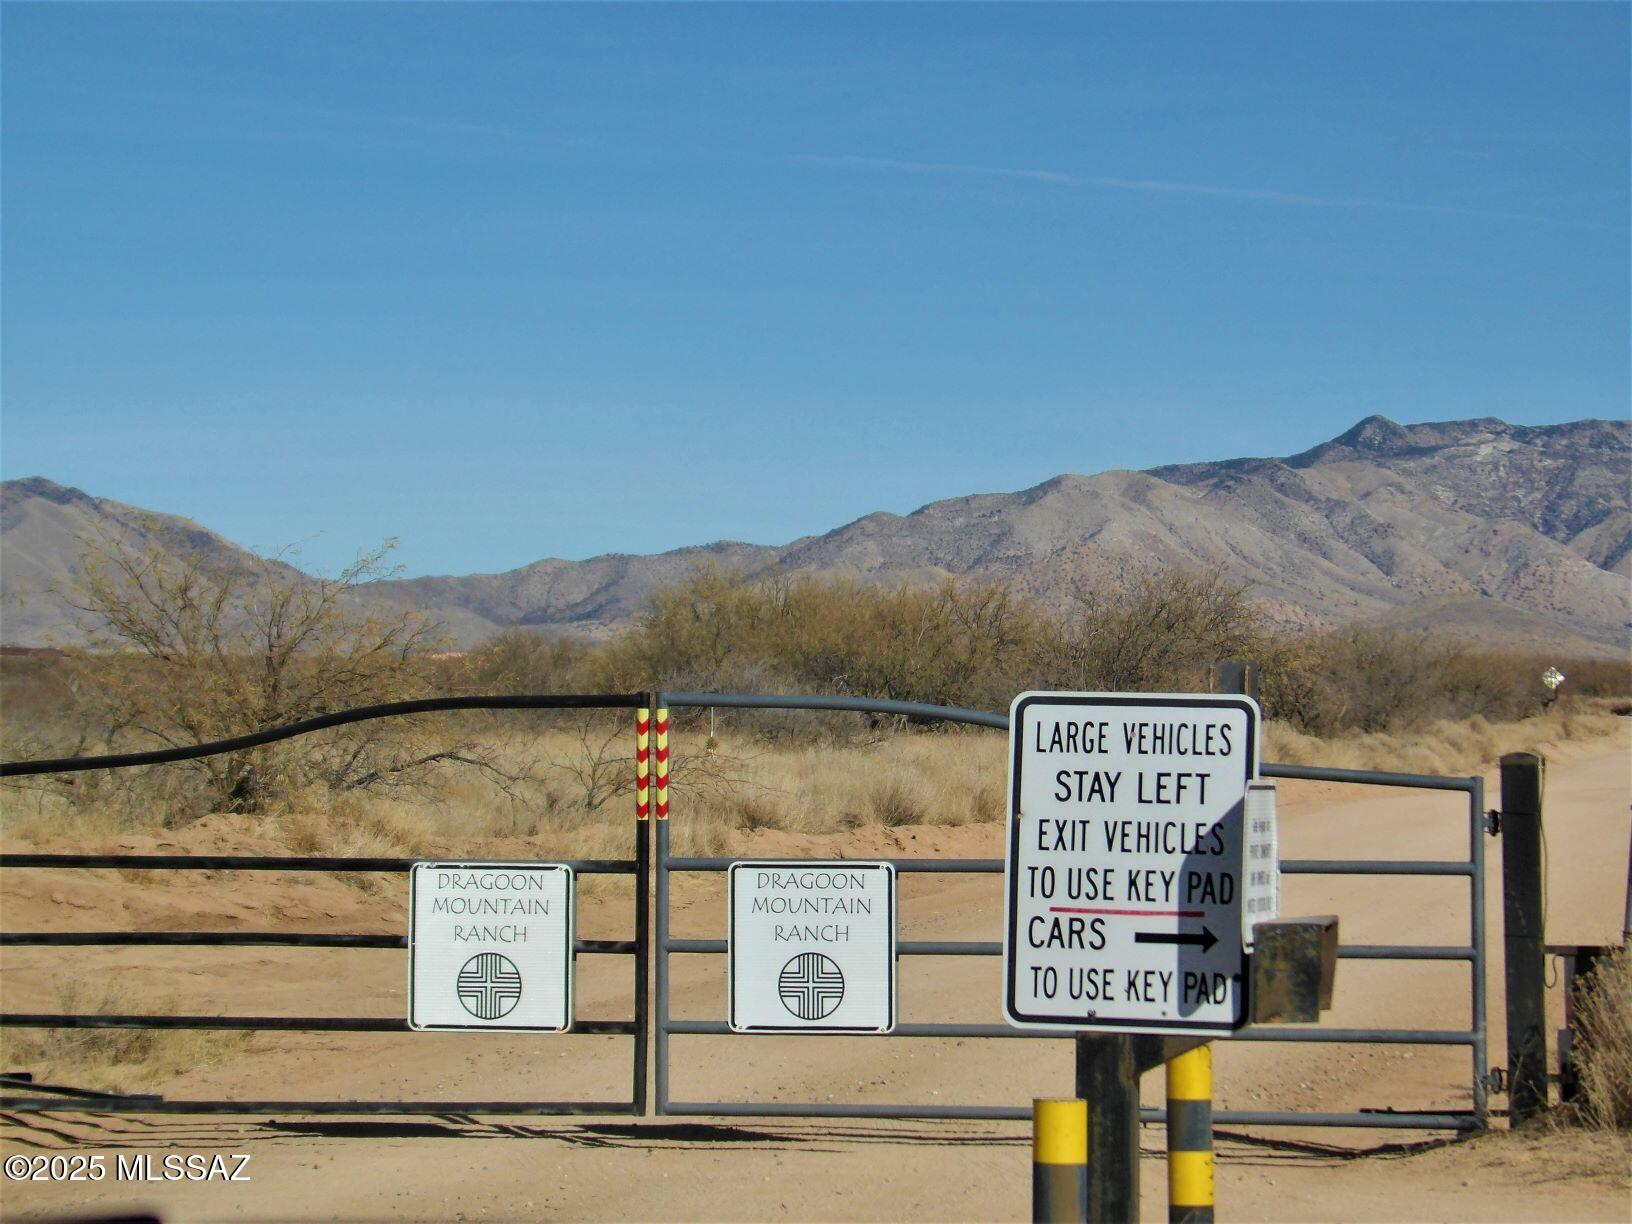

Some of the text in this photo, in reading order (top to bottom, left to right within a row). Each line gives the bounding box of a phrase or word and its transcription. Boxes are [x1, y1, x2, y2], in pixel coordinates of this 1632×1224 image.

[1035, 721, 1232, 756] LARGE VEHICLES
[1054, 770, 1211, 805] STAY LEFT
[1038, 818, 1090, 851] EXIT
[1104, 820, 1225, 856] VEHICLES
[437, 873, 544, 891] DRAGOON
[757, 872, 866, 890] DRAGOON
[1027, 866, 1056, 899] TO
[1067, 867, 1115, 901] USE
[1127, 869, 1175, 902] KEY
[1187, 871, 1234, 905] PAD
[432, 897, 550, 916] MOUNTAIN
[752, 897, 872, 915] MOUNTAIN
[453, 924, 528, 943] RANCH
[774, 924, 850, 942] RANCH
[1028, 915, 1106, 950] CARS
[1030, 966, 1227, 1005] TO USE KEY PAD
